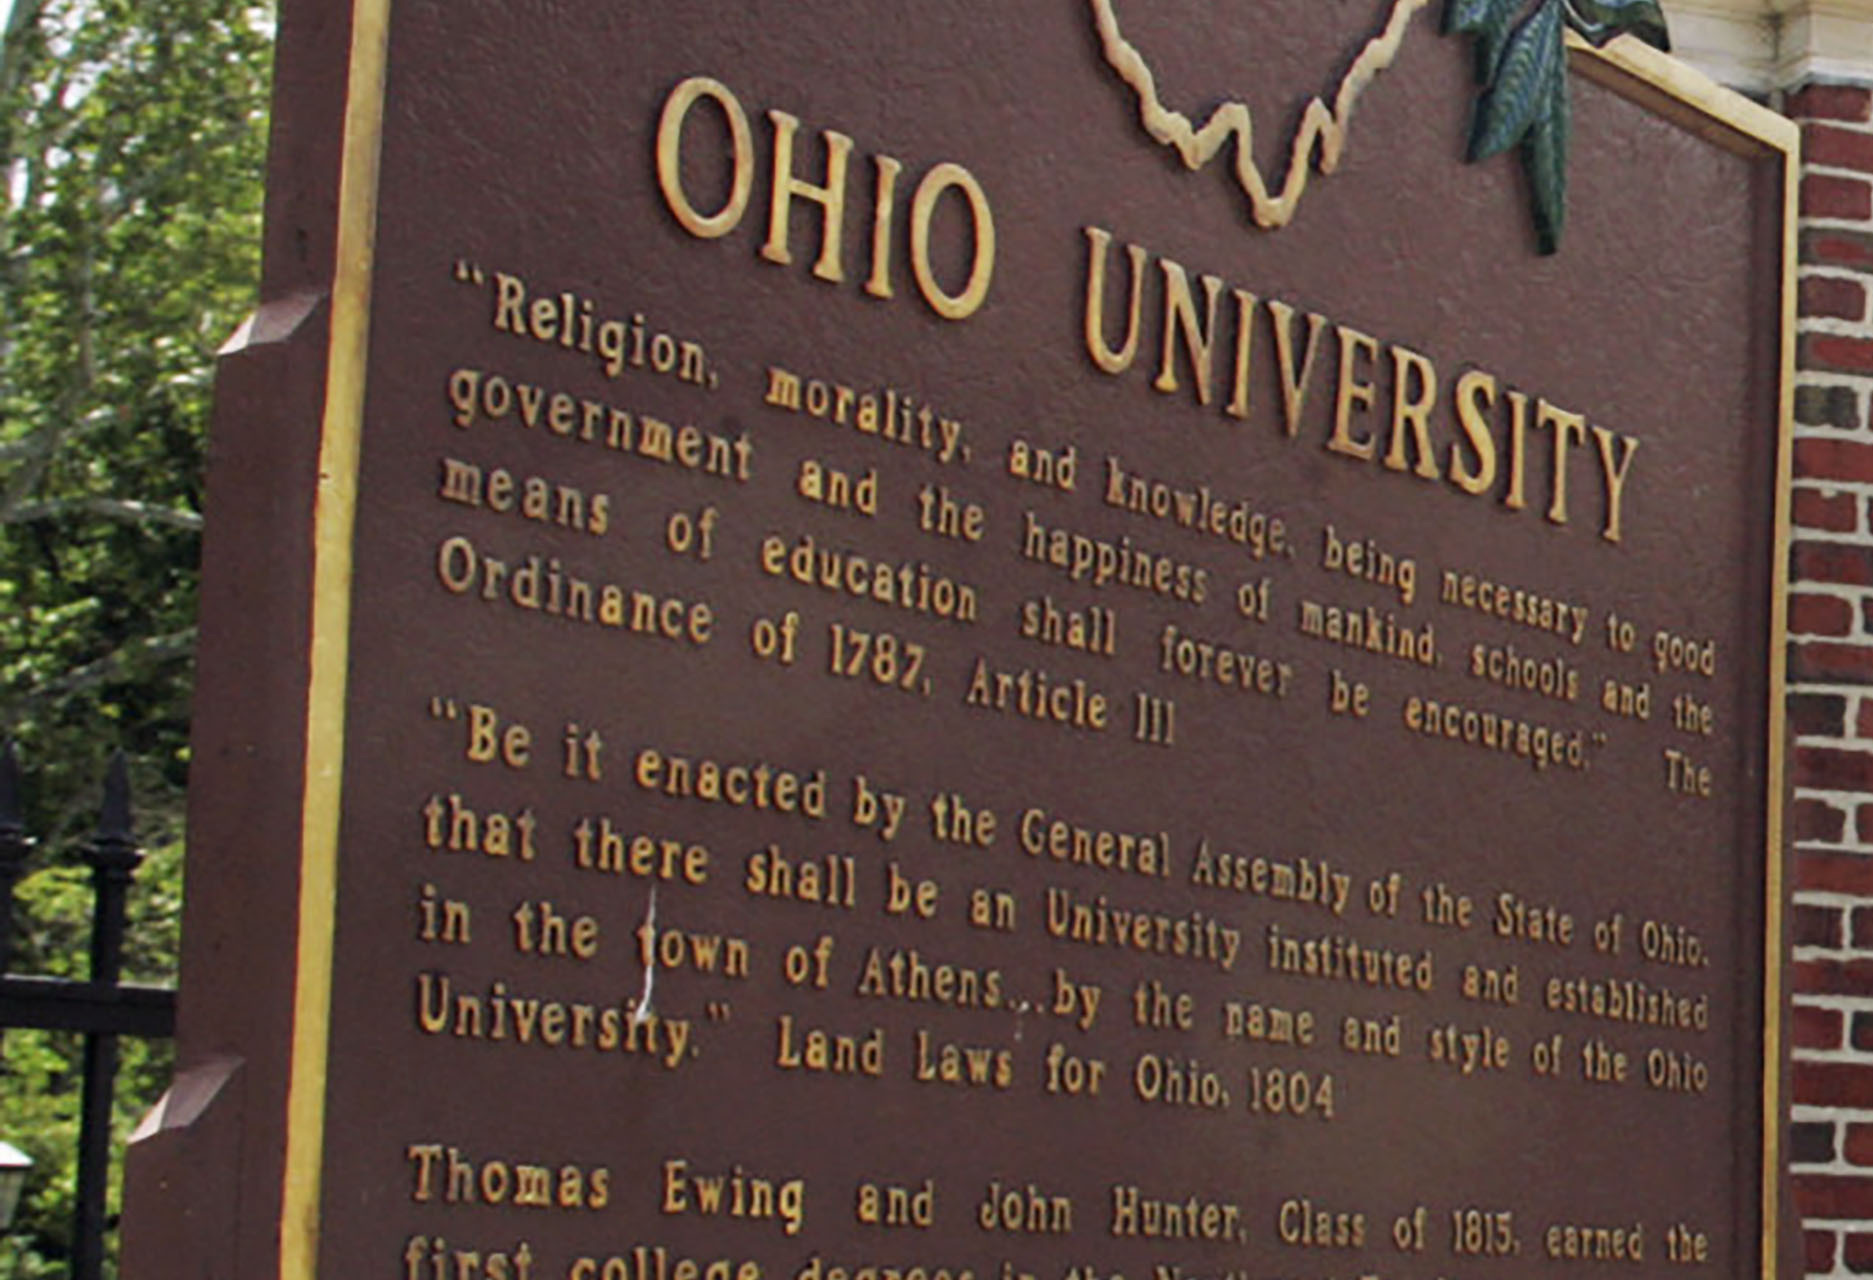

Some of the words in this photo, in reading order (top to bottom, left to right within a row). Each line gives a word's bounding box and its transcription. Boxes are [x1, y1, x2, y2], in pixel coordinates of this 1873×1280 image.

[656, 75, 997, 321] OHIO
[1084, 226, 1640, 544] UNIVERSITY
[439, 536, 712, 643] Ordinance
[753, 611, 799, 662] of
[967, 660, 1106, 728] Article
[442, 458, 609, 534] means
[668, 508, 717, 558] of
[763, 535, 975, 619] education
[1023, 596, 1114, 654] shall
[1163, 625, 1292, 694] forever
[1333, 669, 1368, 716] be
[1665, 749, 1711, 796] The
[450, 369, 752, 480] government
[799, 460, 877, 514] and
[919, 484, 985, 541] the
[1025, 511, 1206, 602] happiness
[1238, 578, 1270, 619] of
[1473, 644, 1578, 700] schools
[1603, 680, 1650, 719] and
[1674, 693, 1713, 735] the
[1010, 440, 1076, 490] and
[1325, 525, 1415, 603] being
[1443, 571, 1588, 644] necessary
[1608, 614, 1635, 652] to
[1655, 631, 1715, 675] good
[424, 794, 535, 859] that
[575, 818, 709, 883] there
[747, 845, 855, 906] shall
[888, 863, 938, 917] be
[972, 889, 1015, 928] an
[1049, 887, 1240, 969] University
[1269, 924, 1432, 990] instituted
[1463, 965, 1518, 1002] and
[1548, 978, 1707, 1029] established
[566, 724, 602, 779] it
[637, 750, 826, 817] enacted
[854, 776, 905, 839] by
[932, 793, 996, 845] the
[1021, 808, 1171, 877] General
[1193, 843, 1350, 914] Assembly
[1370, 873, 1401, 915] of
[1424, 883, 1472, 926] the
[1497, 893, 1572, 943] State
[1595, 914, 1622, 953] of
[421, 884, 470, 942] in
[514, 901, 598, 958] the
[636, 920, 749, 977] town
[786, 936, 833, 987] of
[1135, 981, 1192, 1029] the
[1226, 1002, 1313, 1044] name
[1344, 1016, 1400, 1054] and
[1431, 1024, 1509, 1073] style
[1534, 1035, 1562, 1074] of
[1583, 1040, 1627, 1081] the
[1648, 1048, 1708, 1090] Ohio
[778, 1015, 883, 1074] Land
[917, 1030, 1012, 1087] Laws
[1047, 1043, 1105, 1093] for
[1252, 1067, 1333, 1117] 1804
[409, 1144, 608, 1208] Thomas
[664, 1160, 804, 1235] Ewing
[858, 1180, 933, 1226] and
[981, 1183, 1071, 1231] John
[1280, 1200, 1364, 1245] Class
[1394, 1207, 1426, 1249] of
[1547, 1224, 1643, 1260] earned
[1668, 1224, 1707, 1261] the
